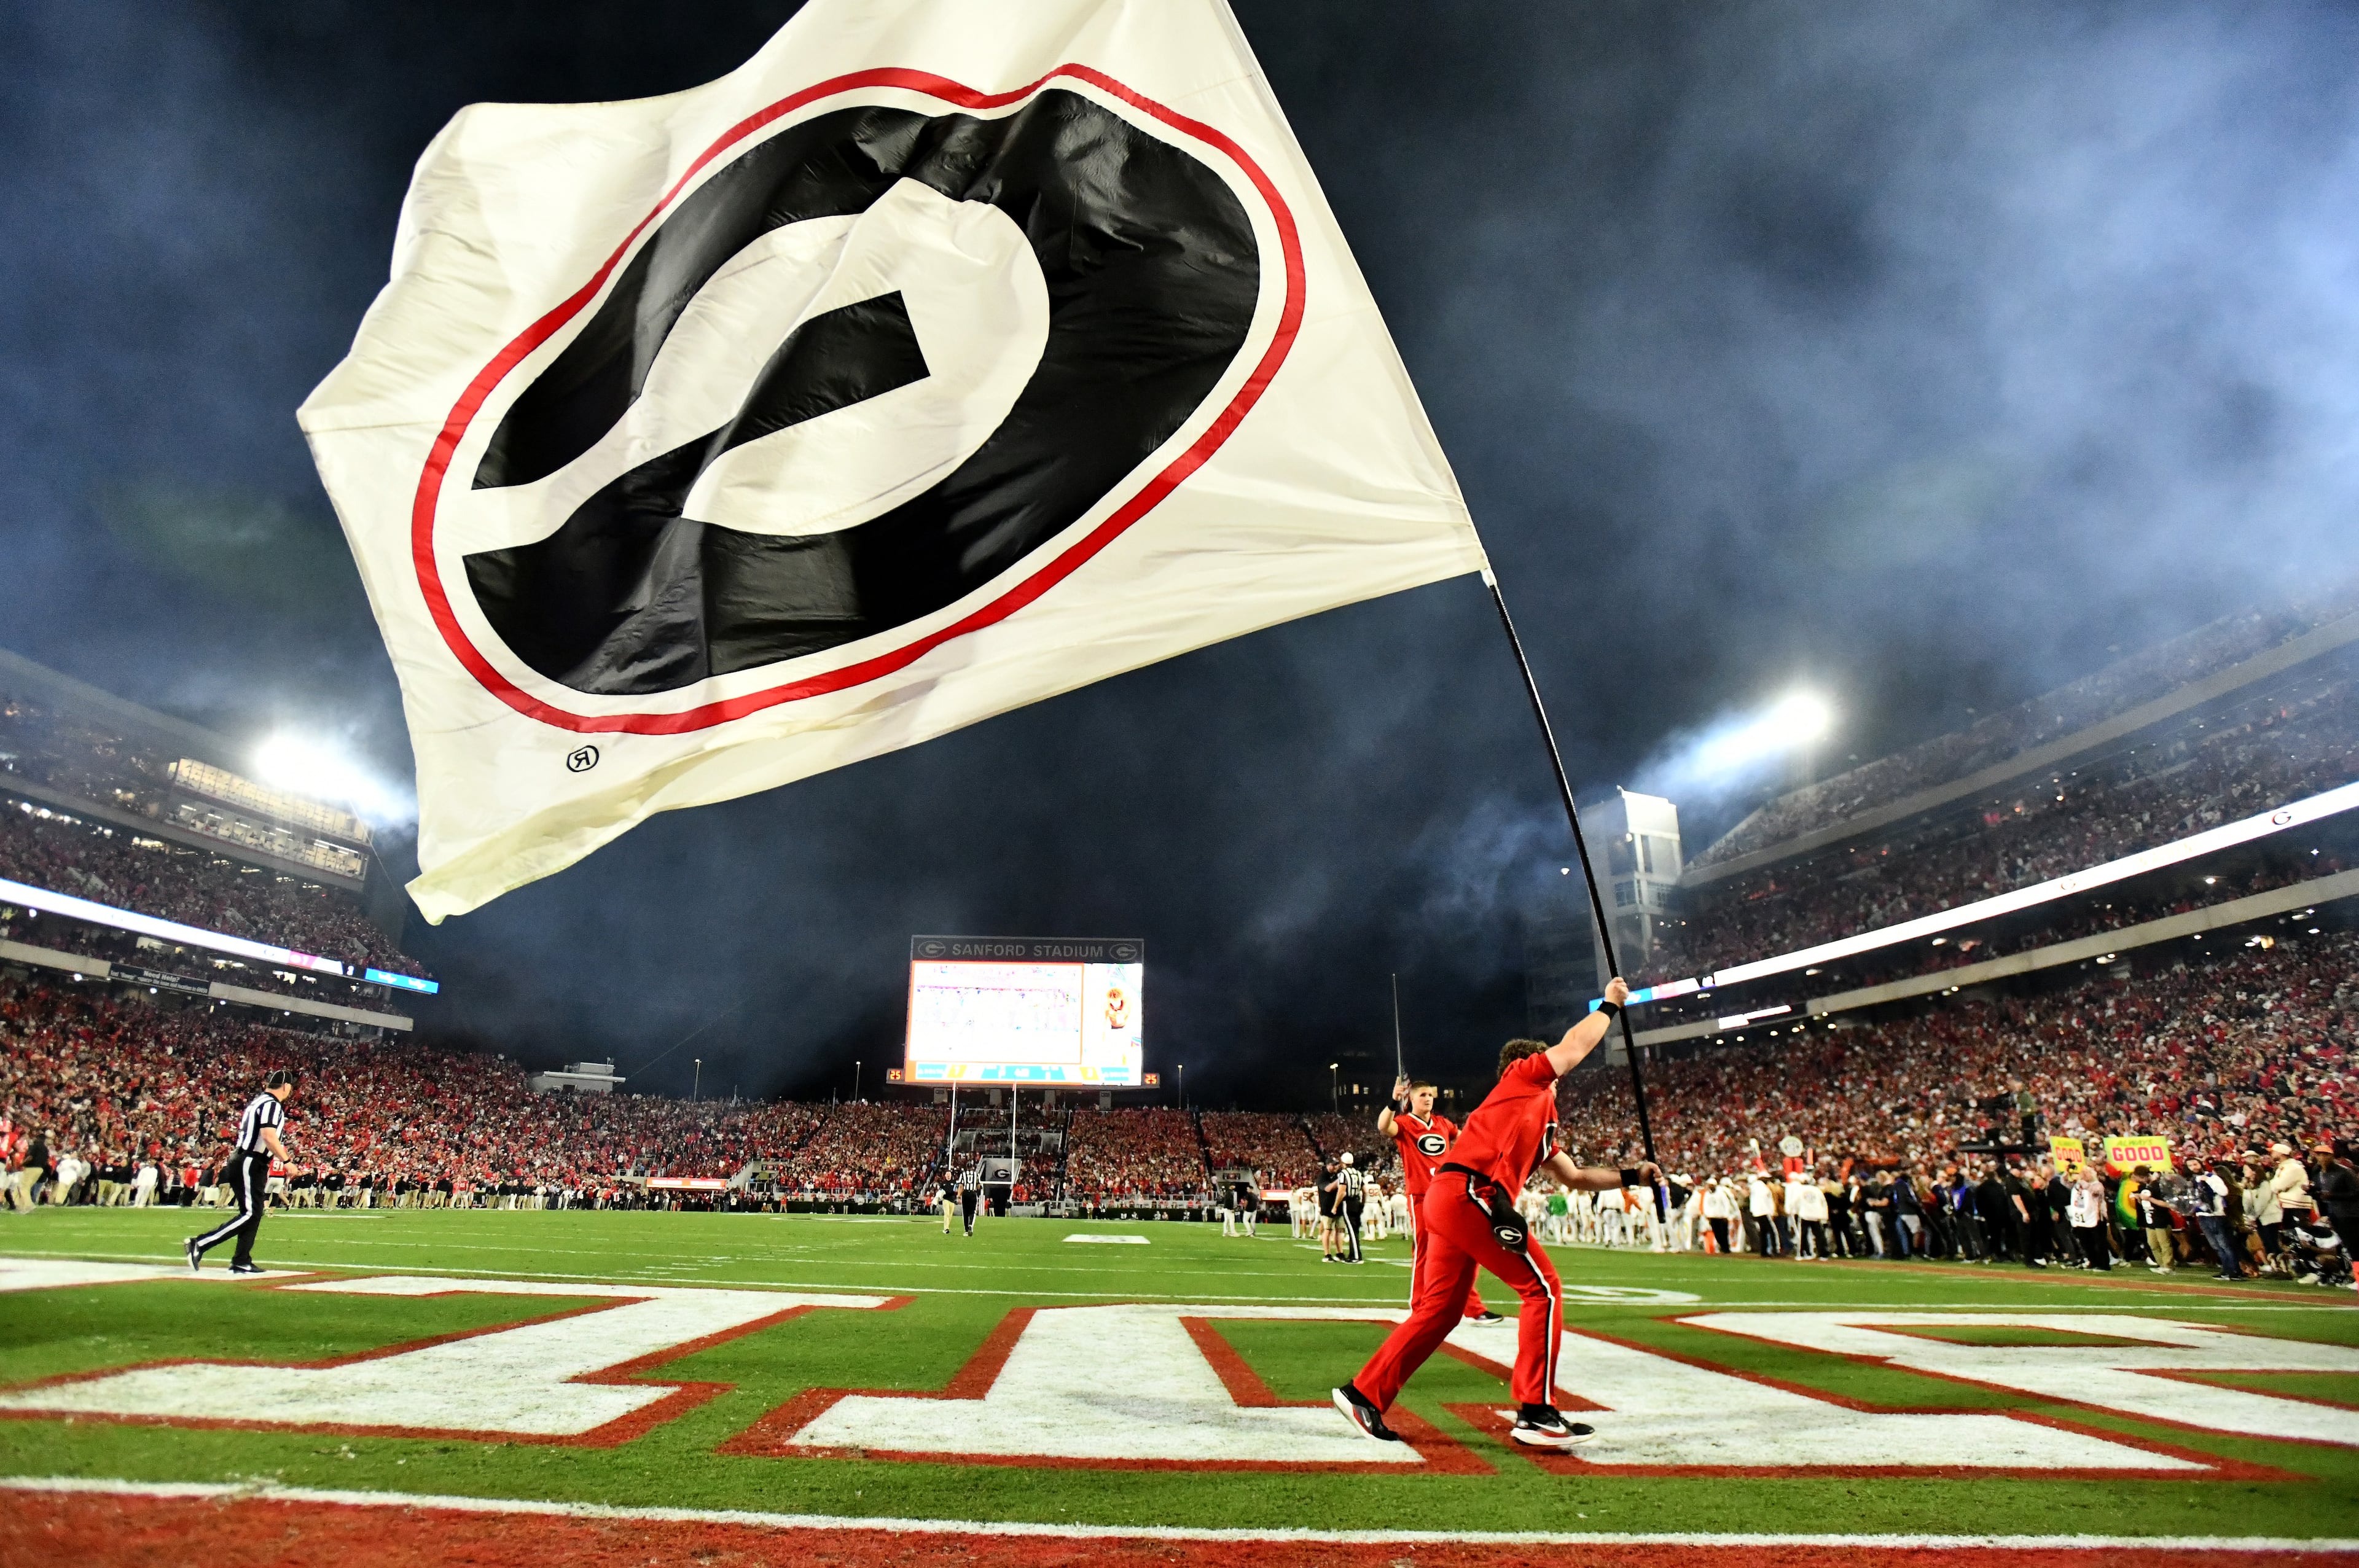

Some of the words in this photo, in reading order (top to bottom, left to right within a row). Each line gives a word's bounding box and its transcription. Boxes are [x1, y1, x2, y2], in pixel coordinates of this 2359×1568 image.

[952, 943, 1025, 957] SANFORD
[1033, 945, 1103, 958] STADIUM
[143, 970, 160, 979] Need
[162, 973, 181, 983] Help?
[890, 1070, 901, 1080] 25
[1145, 1074, 1157, 1085] 25
[1423, 1136, 1446, 1153] G
[2055, 1147, 2083, 1163] GOOD
[2112, 1146, 2164, 1161] GOOD
[272, 1161, 284, 1171] 91
[1499, 1228, 1522, 1241] G
